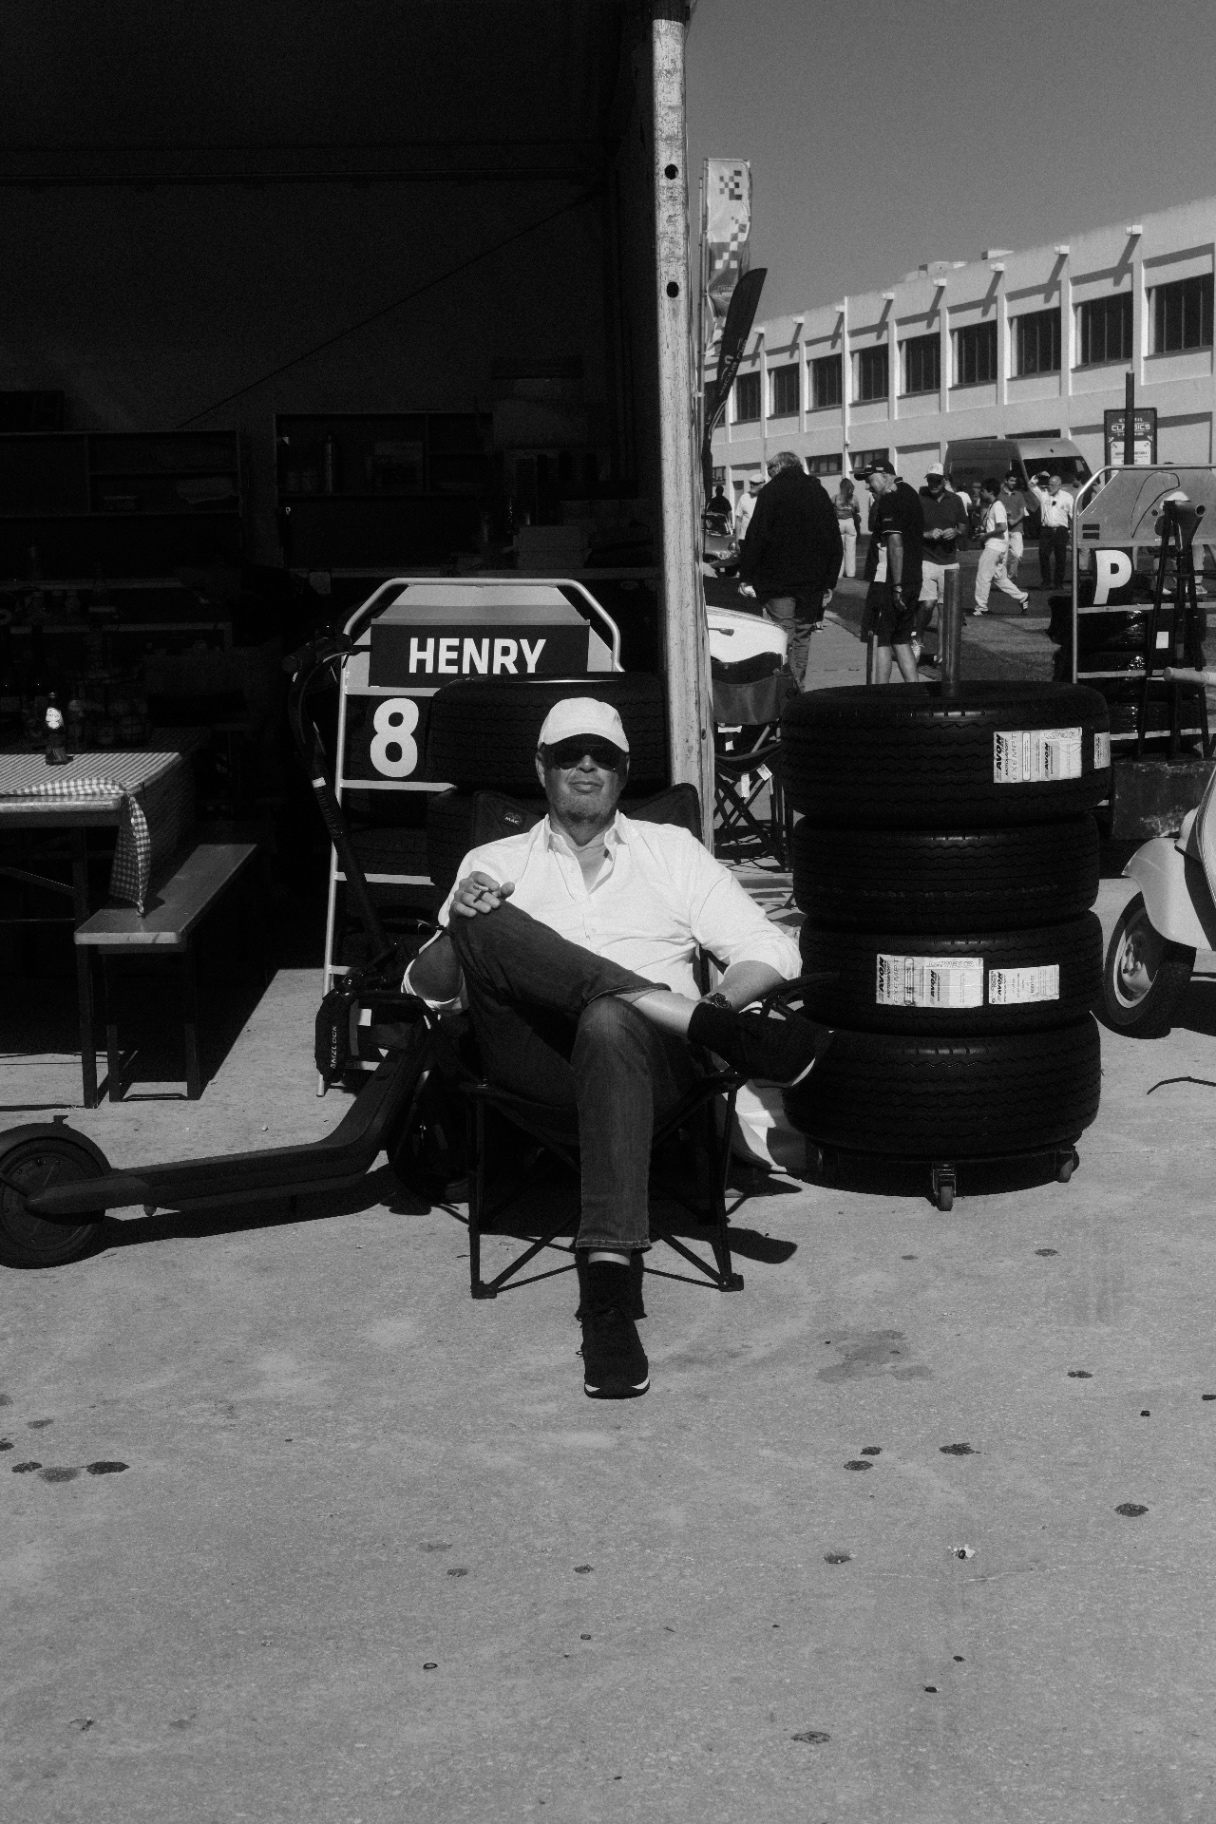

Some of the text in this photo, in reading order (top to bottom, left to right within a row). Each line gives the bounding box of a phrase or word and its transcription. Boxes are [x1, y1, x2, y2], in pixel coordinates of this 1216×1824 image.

[1093, 549, 1132, 605] P
[408, 637, 547, 675] HENRY
[369, 697, 419, 778] 8
